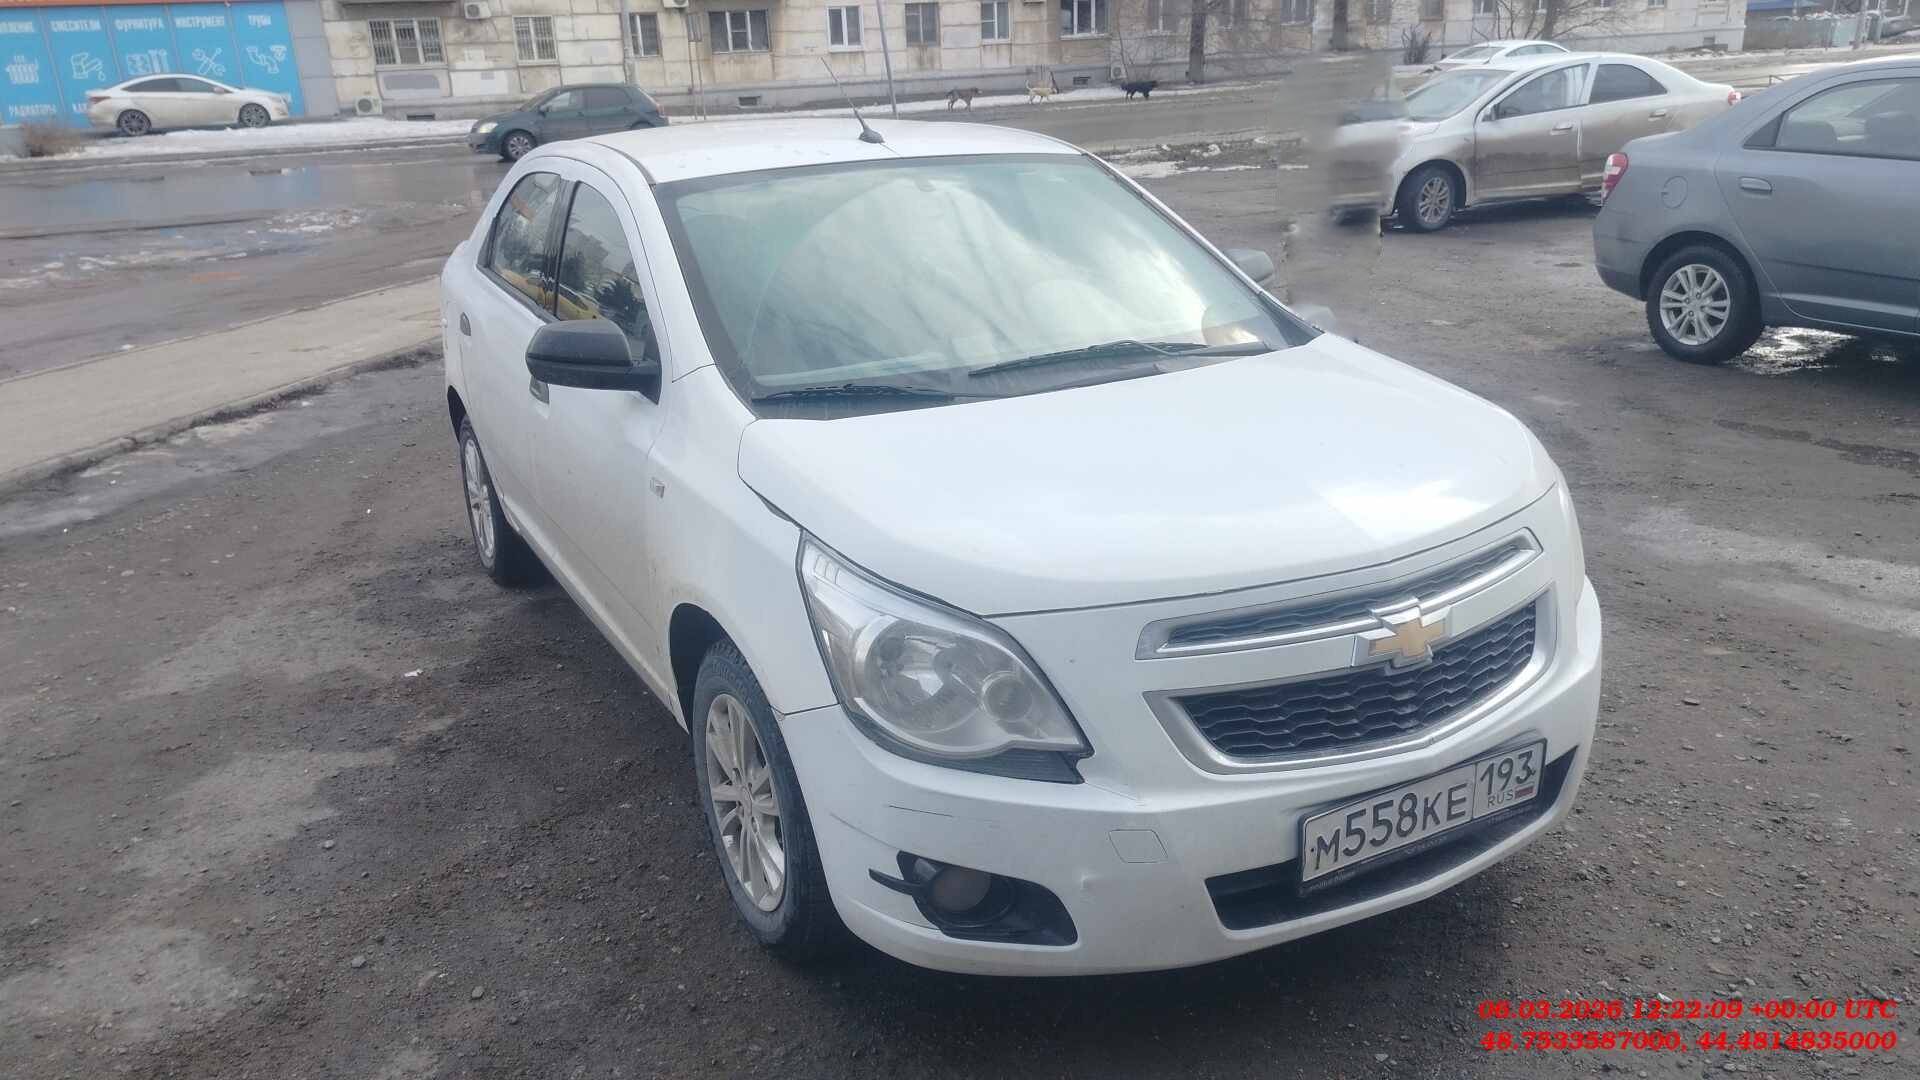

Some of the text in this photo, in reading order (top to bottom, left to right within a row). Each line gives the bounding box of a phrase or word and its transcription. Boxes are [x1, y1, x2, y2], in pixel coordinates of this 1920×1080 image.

[1480, 750, 1536, 795] 193
[1487, 789, 1514, 808] RUS
[1315, 782, 1468, 870] М558КЕ
